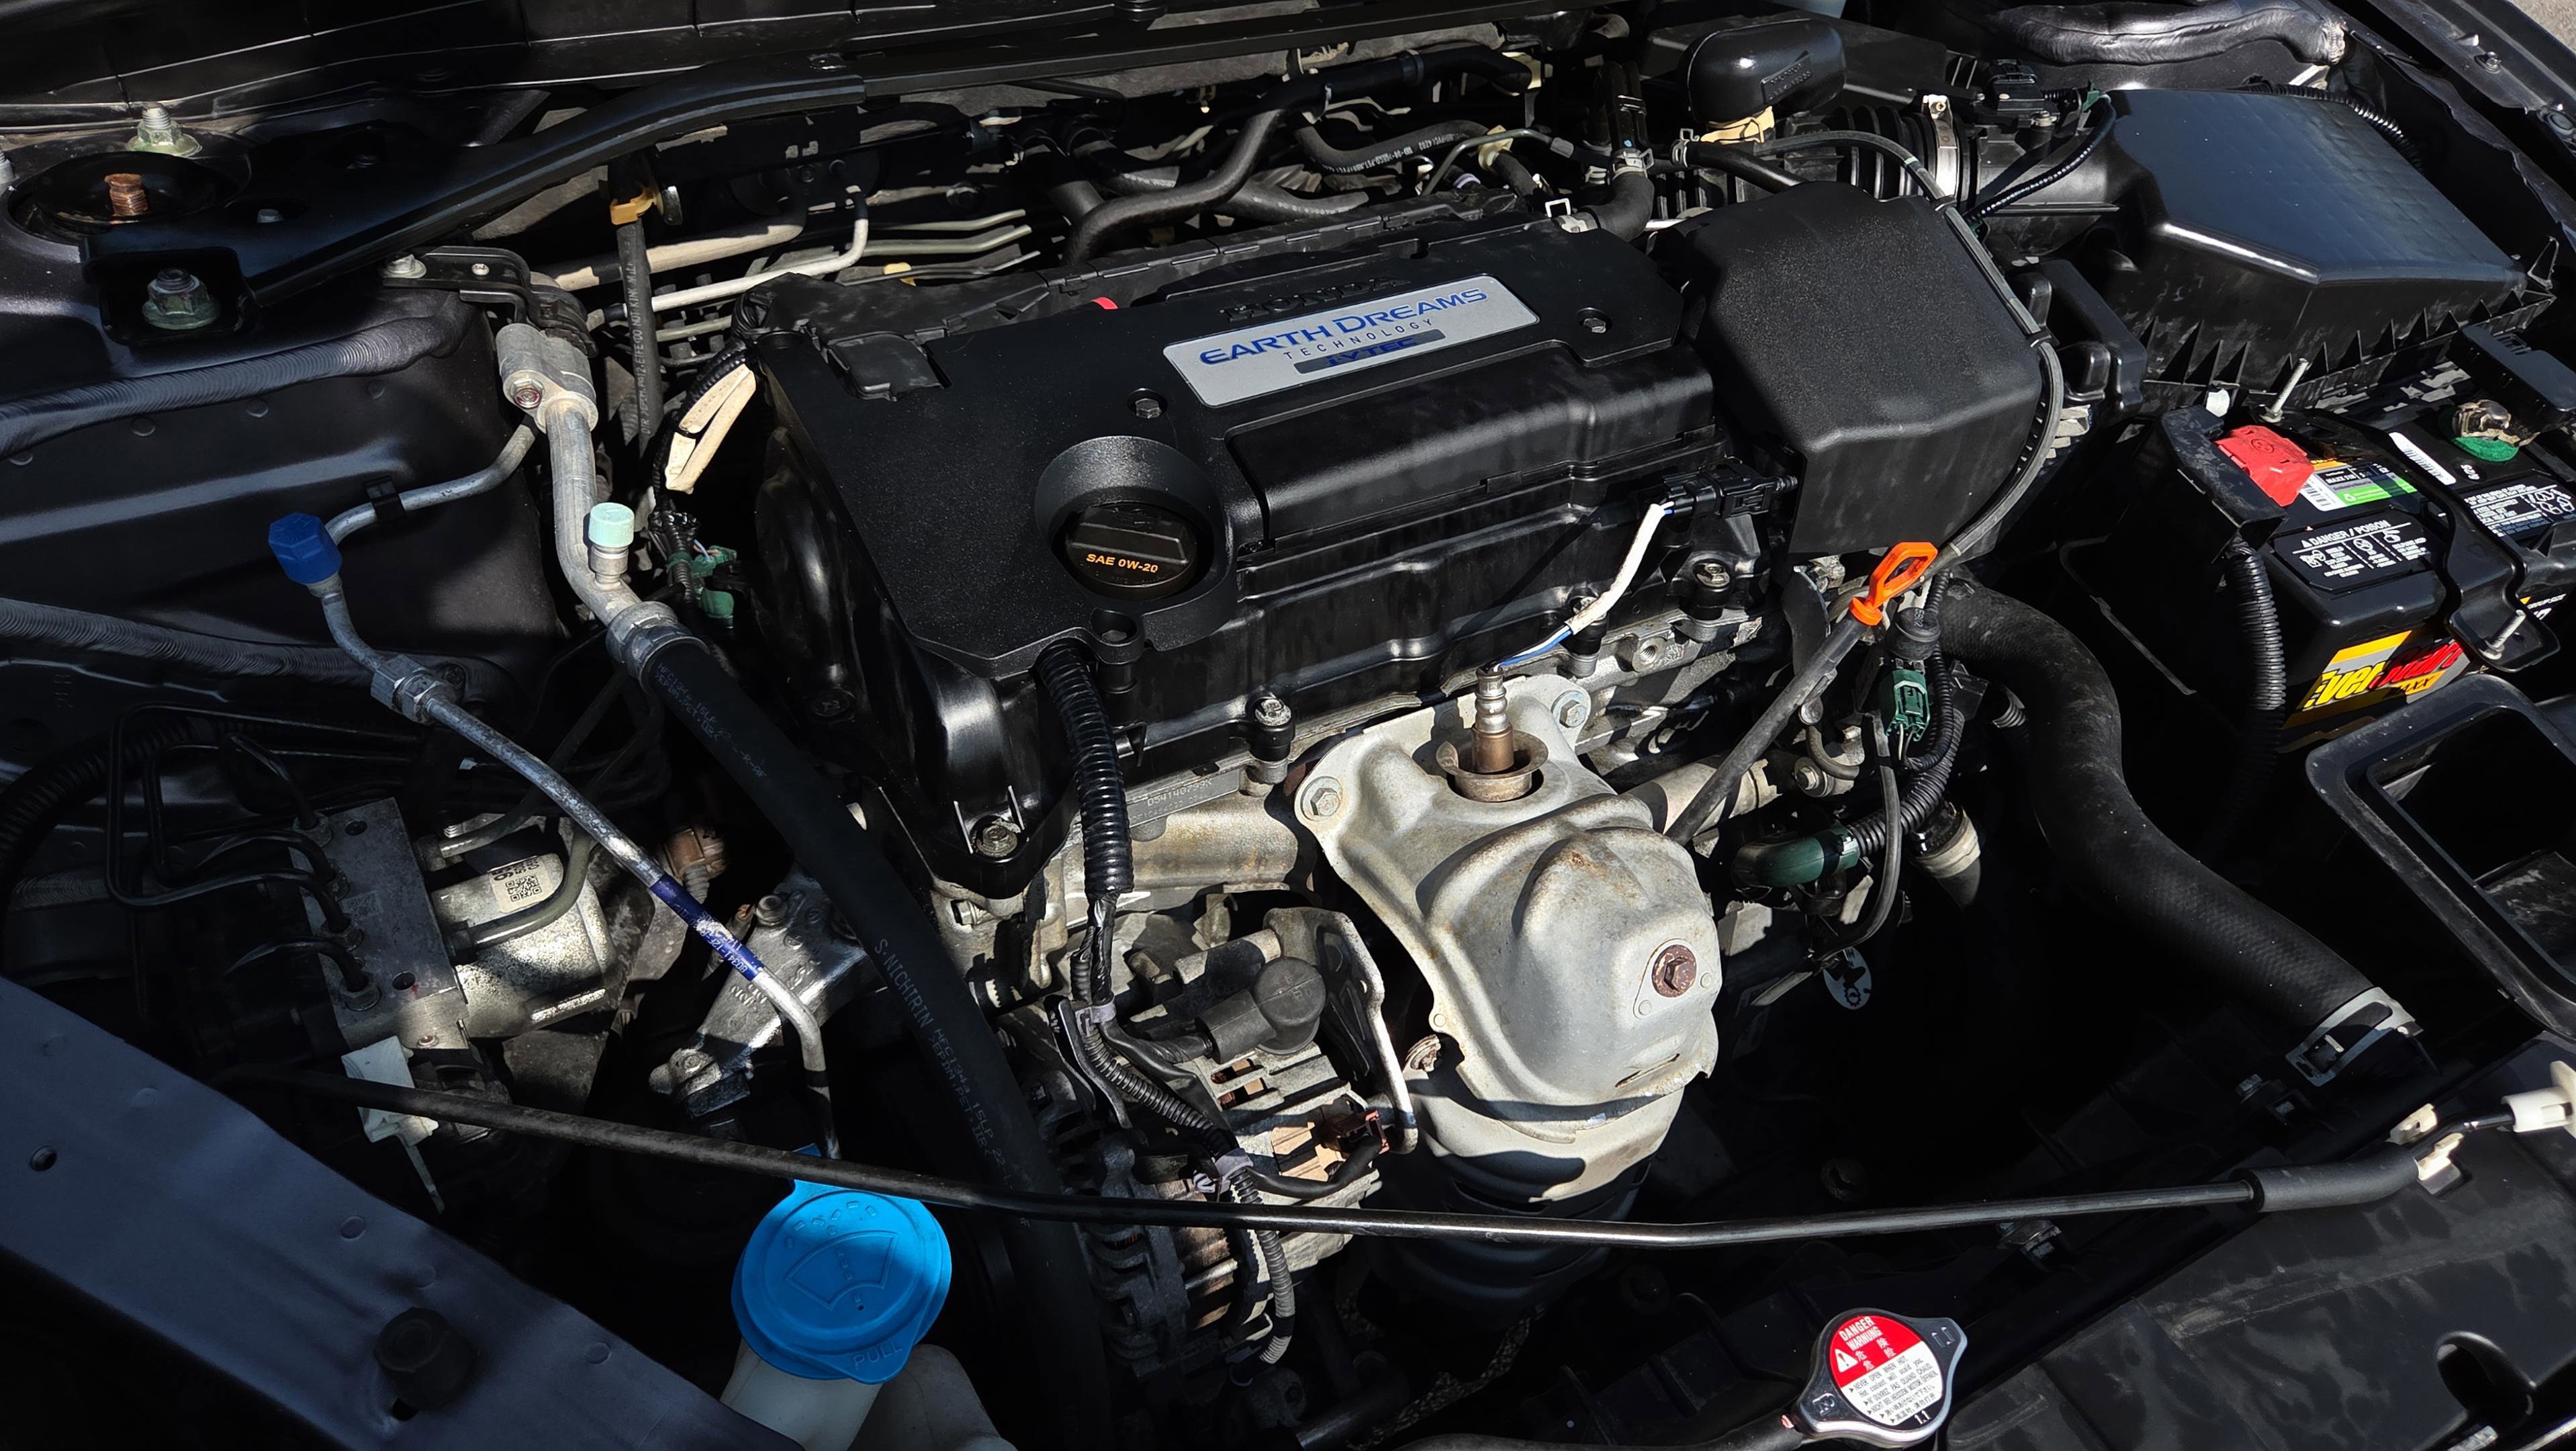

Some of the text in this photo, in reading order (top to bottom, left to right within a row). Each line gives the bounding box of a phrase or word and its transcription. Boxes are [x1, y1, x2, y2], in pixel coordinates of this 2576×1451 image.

[1219, 277, 1411, 323] HONDA
[1200, 288, 1488, 365] EARTH DREAMS
[1283, 318, 1433, 359] TECHNOLOGY
[2309, 529, 2350, 545] DANGER
[2353, 520, 2391, 534] POISON
[1085, 553, 1158, 574] SAE 0W-20
[1839, 1316, 1875, 1342] DANGER
[1846, 1326, 1883, 1351] WARNUNG
[852, 1341, 903, 1371] PULL
[1869, 1372, 1882, 1382] OPEN
[1883, 1362, 1896, 1374] WHEN
[1870, 1379, 1886, 1392] coolant
